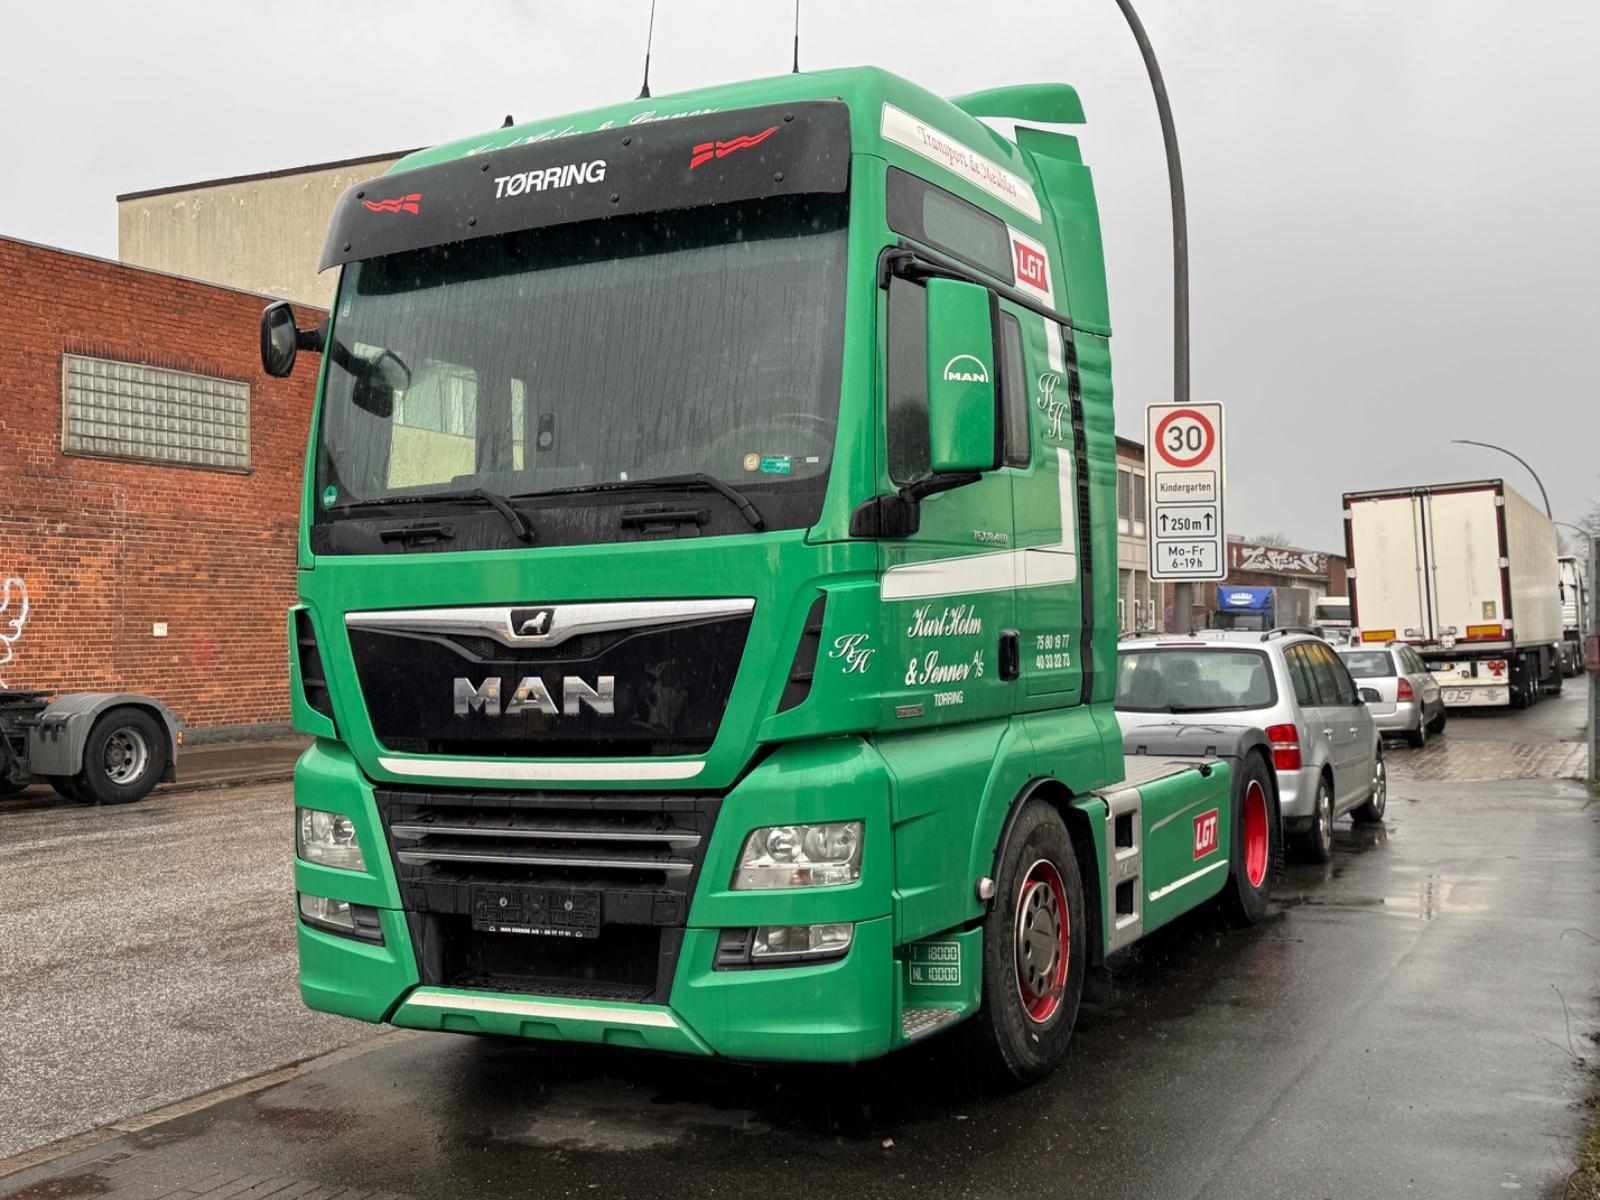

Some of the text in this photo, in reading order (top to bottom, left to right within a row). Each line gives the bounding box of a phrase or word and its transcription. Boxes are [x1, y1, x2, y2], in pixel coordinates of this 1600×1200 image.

[494, 160, 606, 198] TØRRING
[1019, 249, 1043, 280] LGT
[948, 371, 985, 383] MAN
[1168, 425, 1202, 452] 30
[1160, 483, 1211, 494] Kindergarten
[1168, 546, 1205, 556] Mo-Fr
[907, 604, 982, 638] Kurt Holm
[905, 658, 918, 686] &
[972, 650, 985, 679] A/S
[454, 676, 614, 714] MAN
[1195, 816, 1217, 851] LGT
[928, 946, 957, 960] 18000
[912, 967, 958, 981] NL 10000
